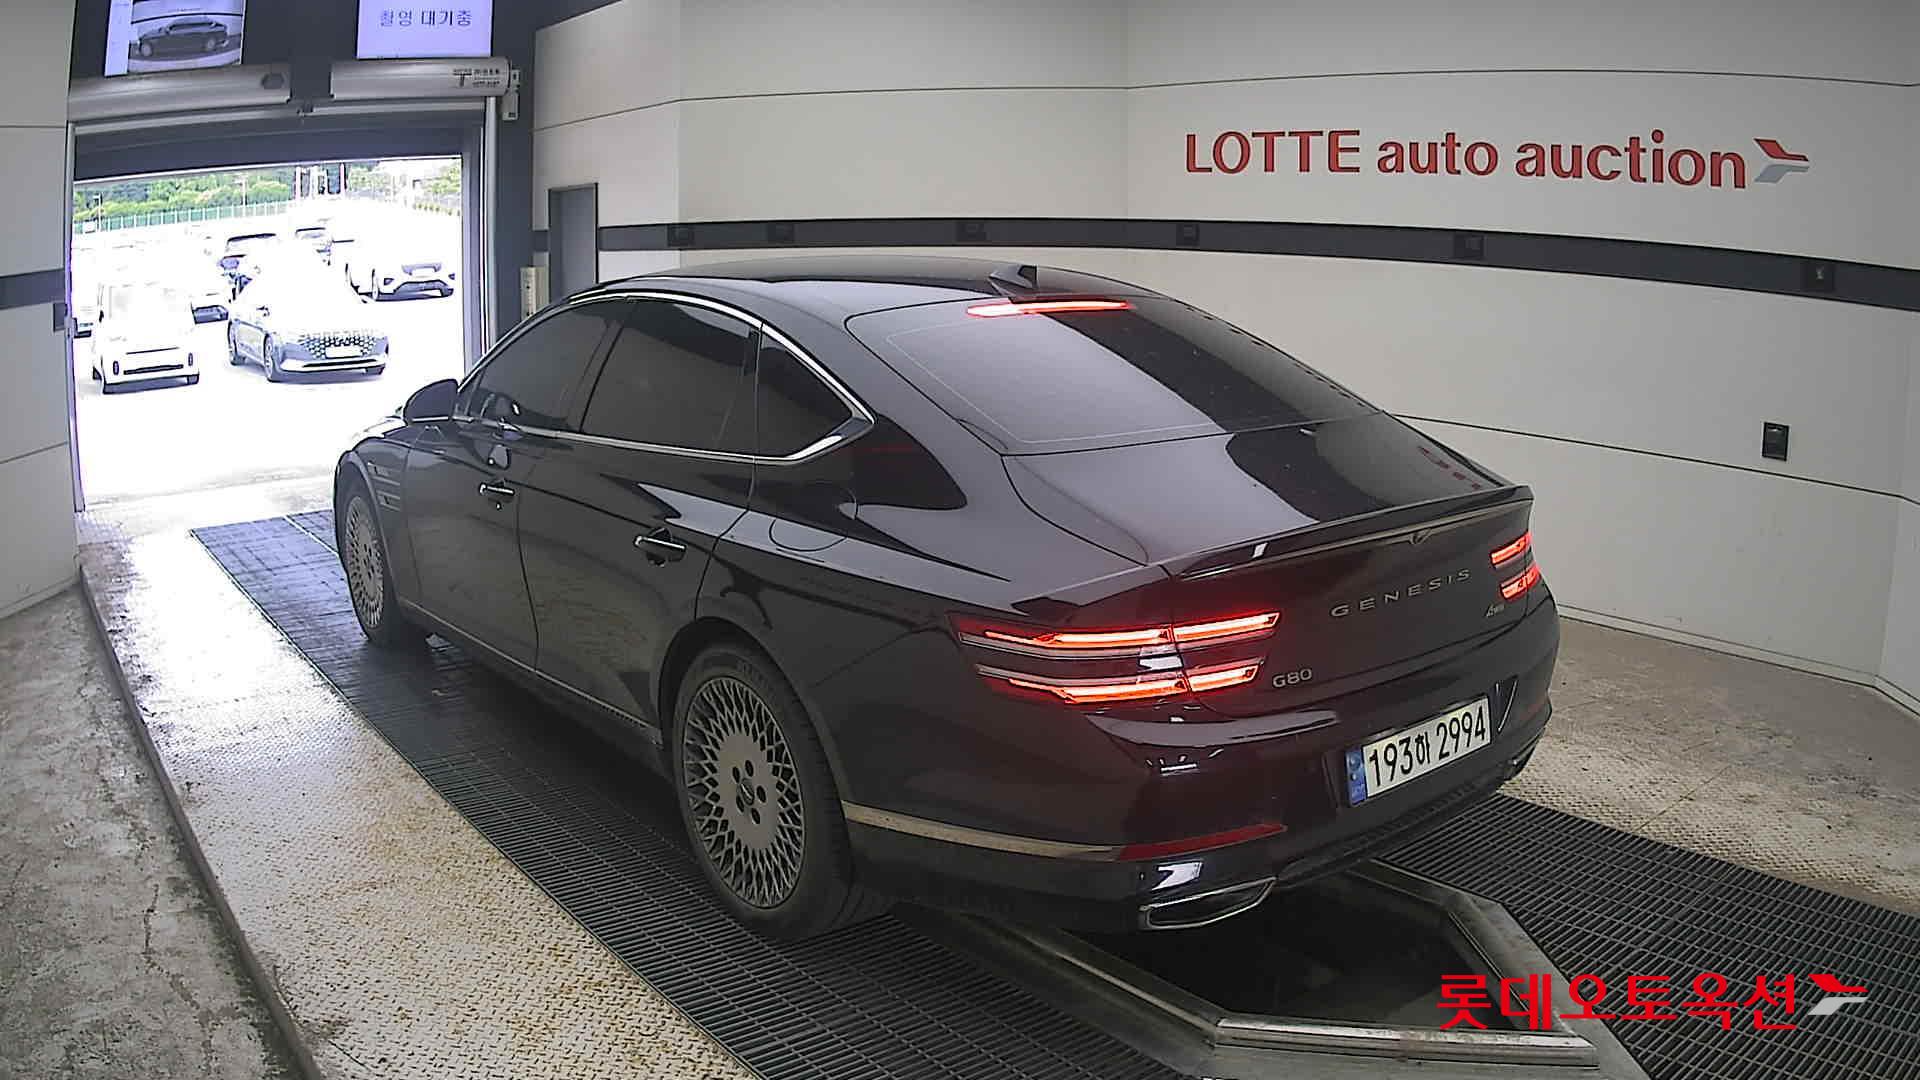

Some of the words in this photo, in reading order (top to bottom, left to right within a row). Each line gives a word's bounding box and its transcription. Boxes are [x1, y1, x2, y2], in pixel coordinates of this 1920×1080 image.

[421, 9, 472, 27] 대기중
[1185, 129, 1361, 174] LOTTE
[1377, 132, 1499, 176] auto
[1515, 128, 1746, 189] auction
[1330, 568, 1471, 618] GENESIS
[1272, 668, 1313, 689] G80
[1368, 731, 1431, 787] 193하
[1436, 705, 1486, 761] 2994
